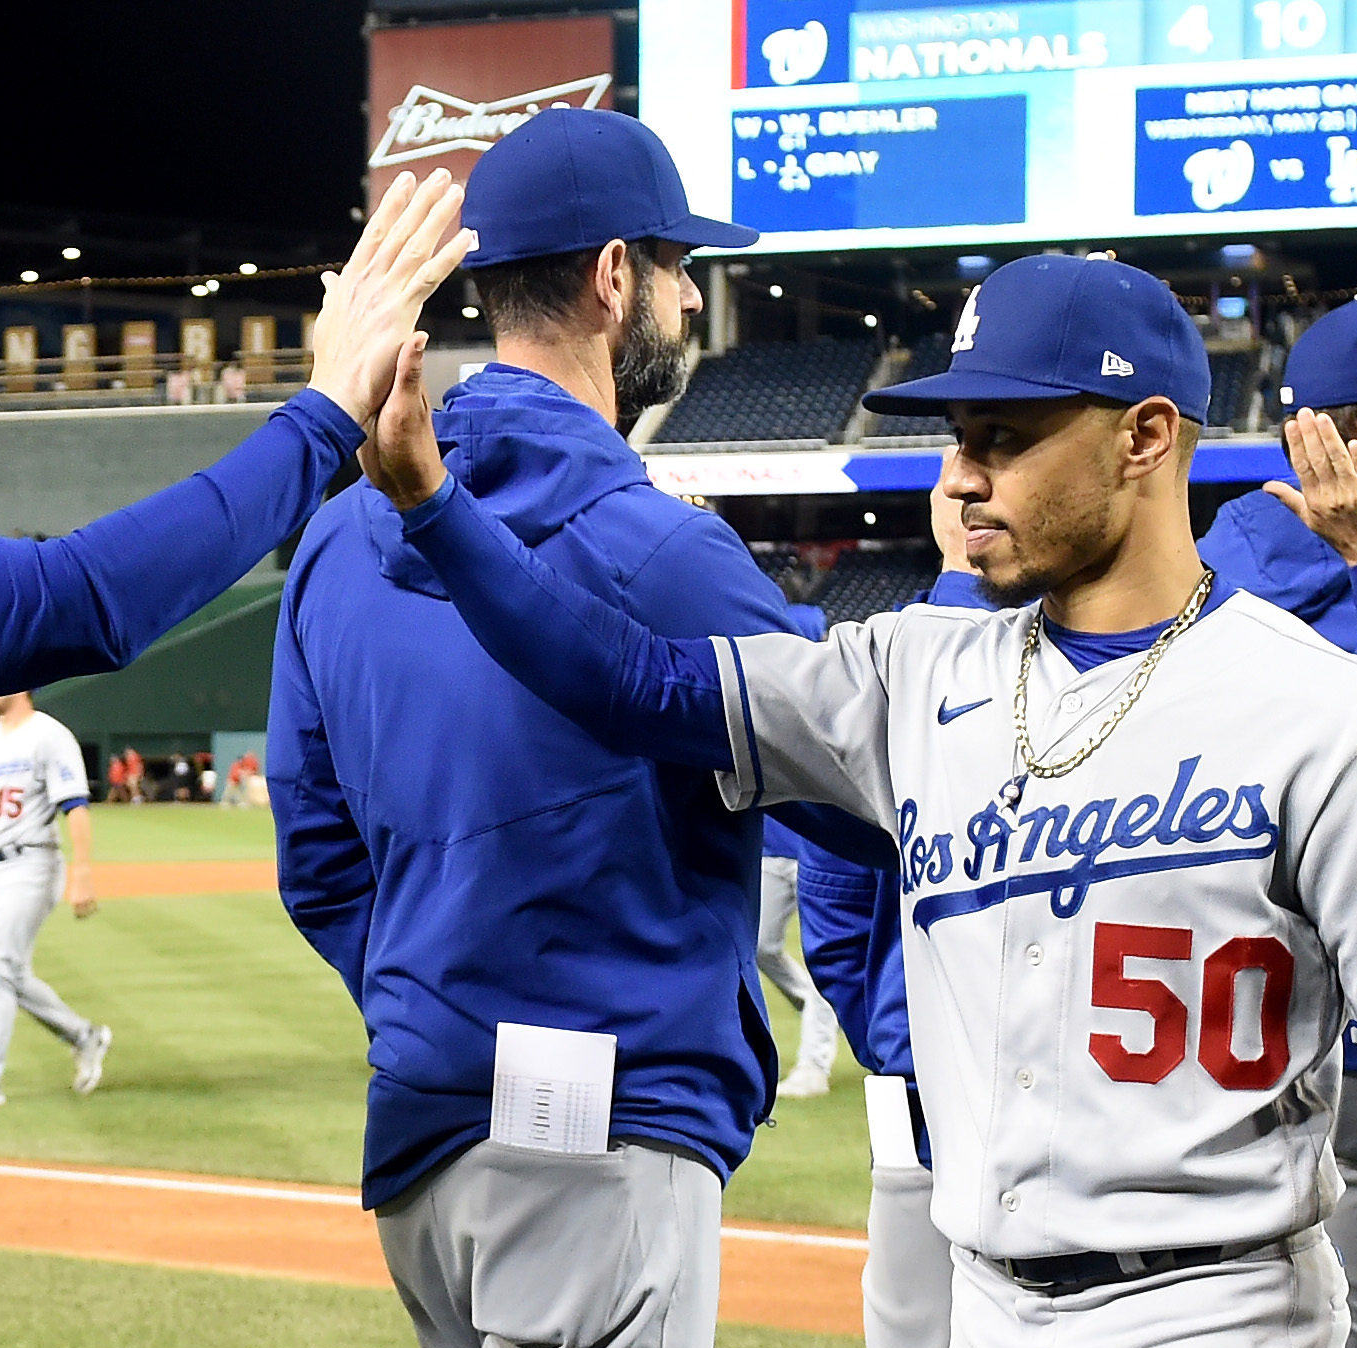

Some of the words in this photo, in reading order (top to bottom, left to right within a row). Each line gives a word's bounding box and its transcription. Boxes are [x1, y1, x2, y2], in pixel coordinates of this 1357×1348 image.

[857, 11, 1019, 39] WASHINGTON
[1168, 4, 1213, 53] 4
[1254, 0, 1327, 50] 10
[854, 31, 1108, 81] NATIONALS
[1249, 86, 1321, 112] HOME
[818, 106, 938, 137] BUEHLER
[805, 150, 879, 177] GRAY
[896, 798, 953, 896] Los
[965, 755, 1279, 918] Angeles
[1088, 921, 1294, 1091] 50
